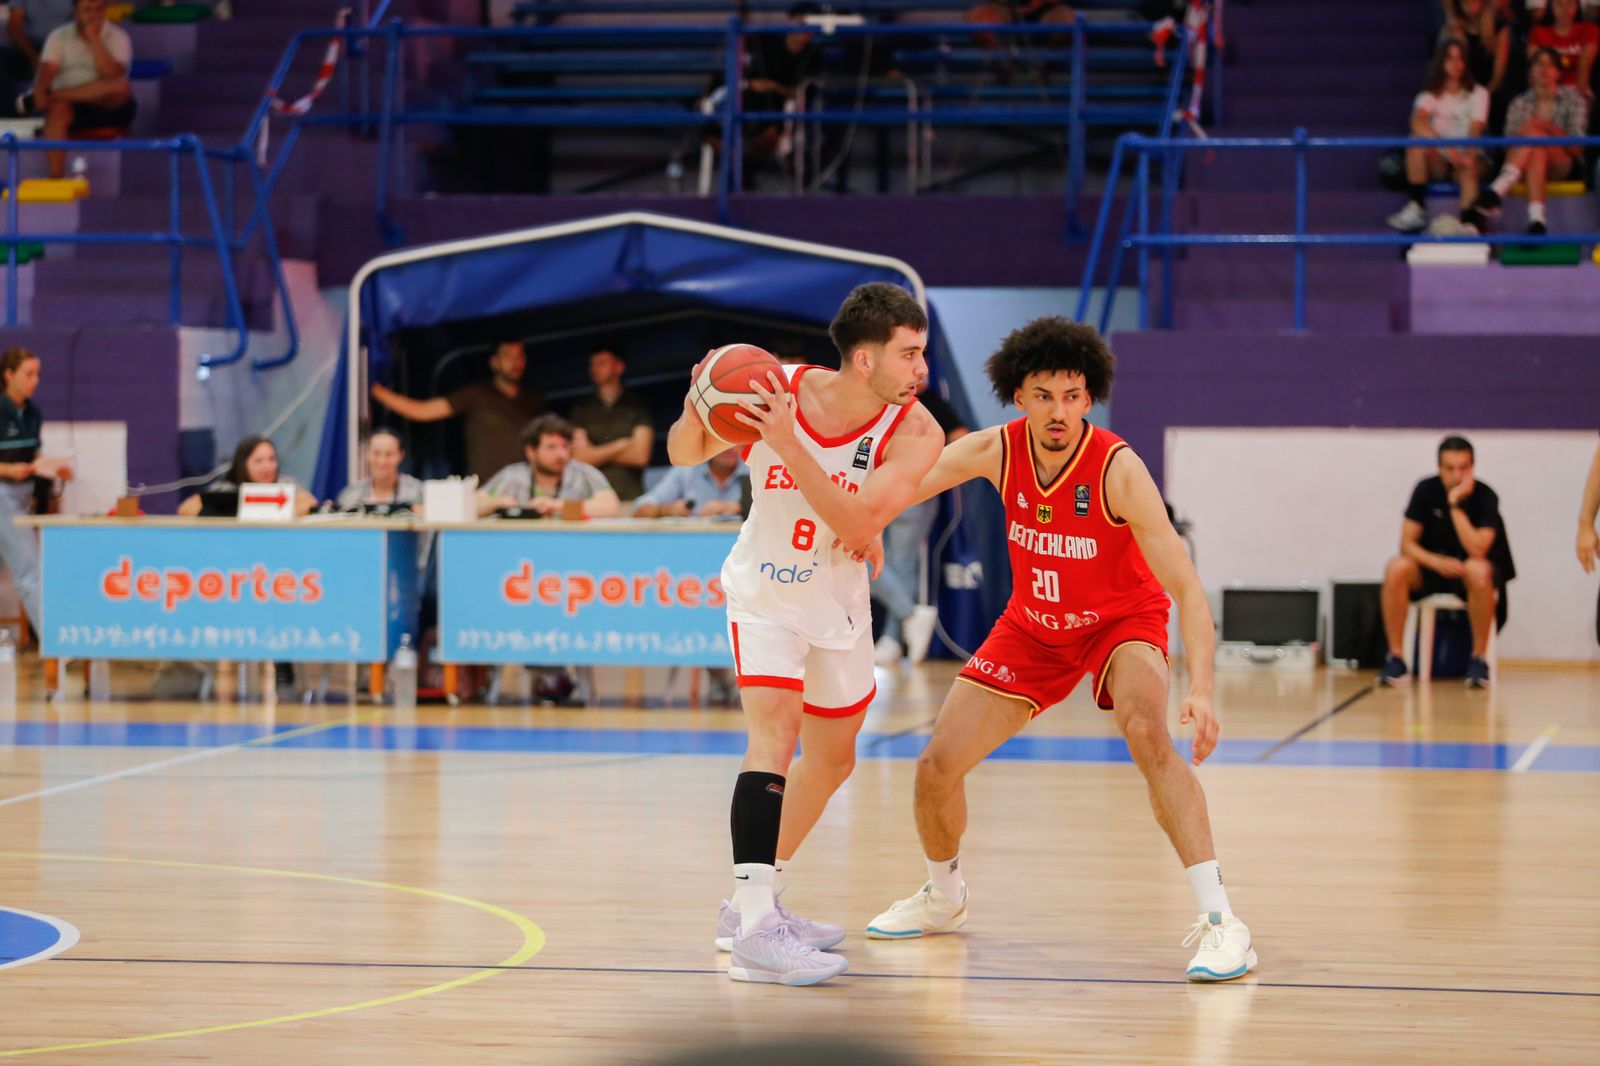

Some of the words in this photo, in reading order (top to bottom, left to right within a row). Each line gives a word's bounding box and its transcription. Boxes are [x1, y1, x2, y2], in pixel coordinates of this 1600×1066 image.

[792, 518, 816, 551] 8
[102, 556, 324, 611] deportes
[502, 560, 726, 615] deportes
[1031, 567, 1060, 603] 20
[966, 656, 994, 674] ING
